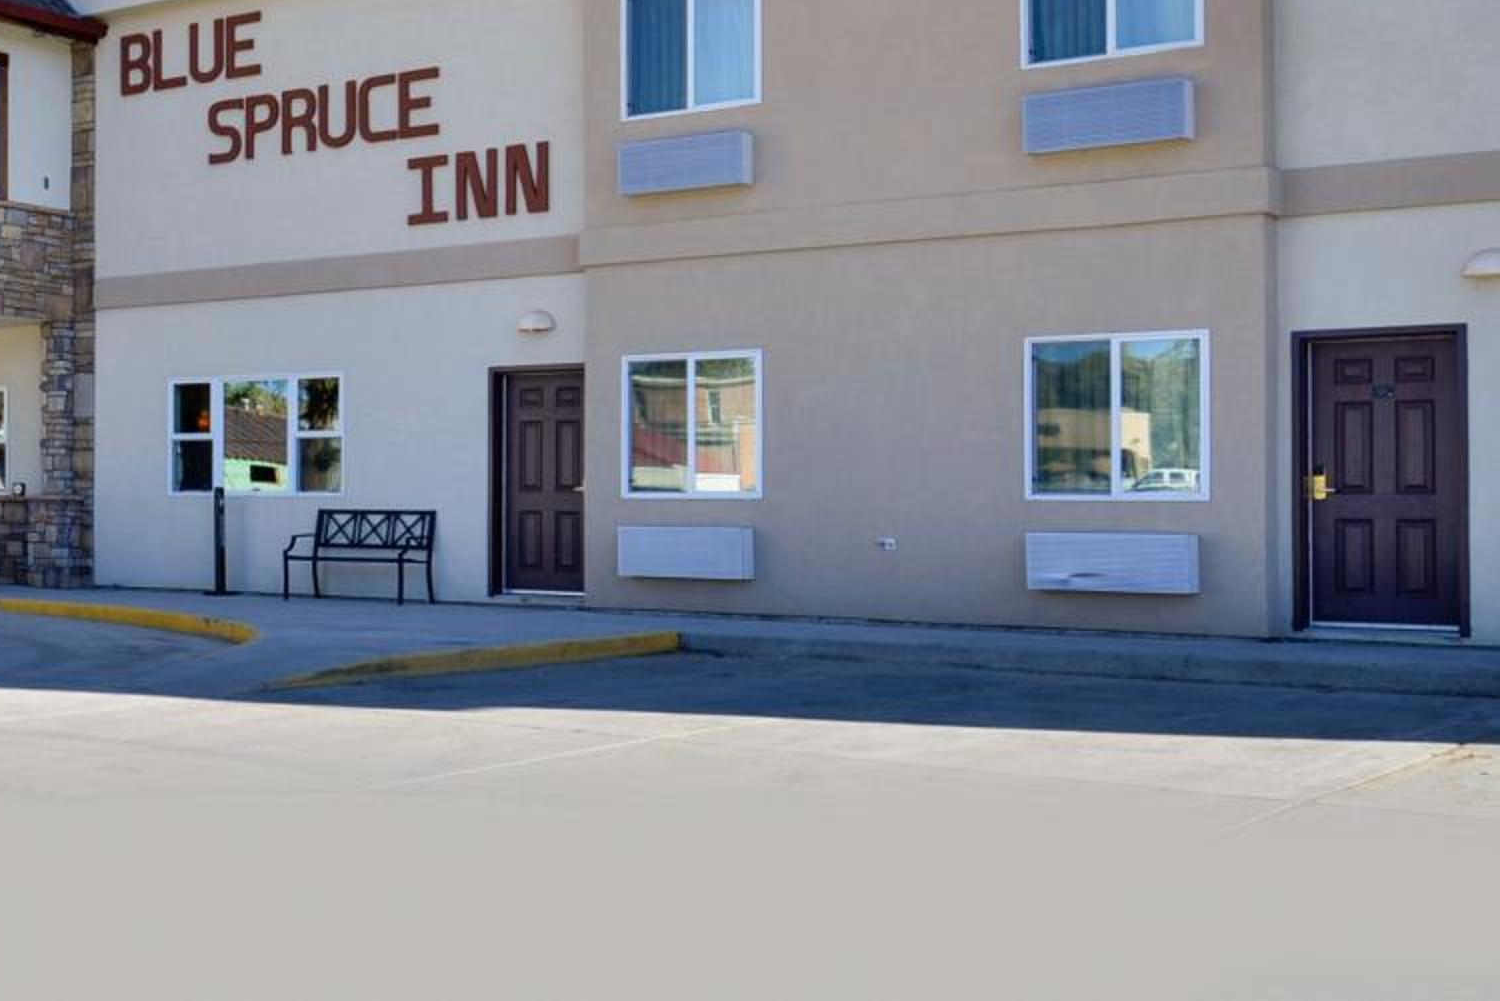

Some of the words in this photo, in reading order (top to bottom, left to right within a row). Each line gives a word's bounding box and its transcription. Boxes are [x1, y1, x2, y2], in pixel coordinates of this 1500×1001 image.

[119, 11, 262, 97] BLUE
[207, 66, 440, 165] SPRUCE
[406, 141, 549, 226] INN
